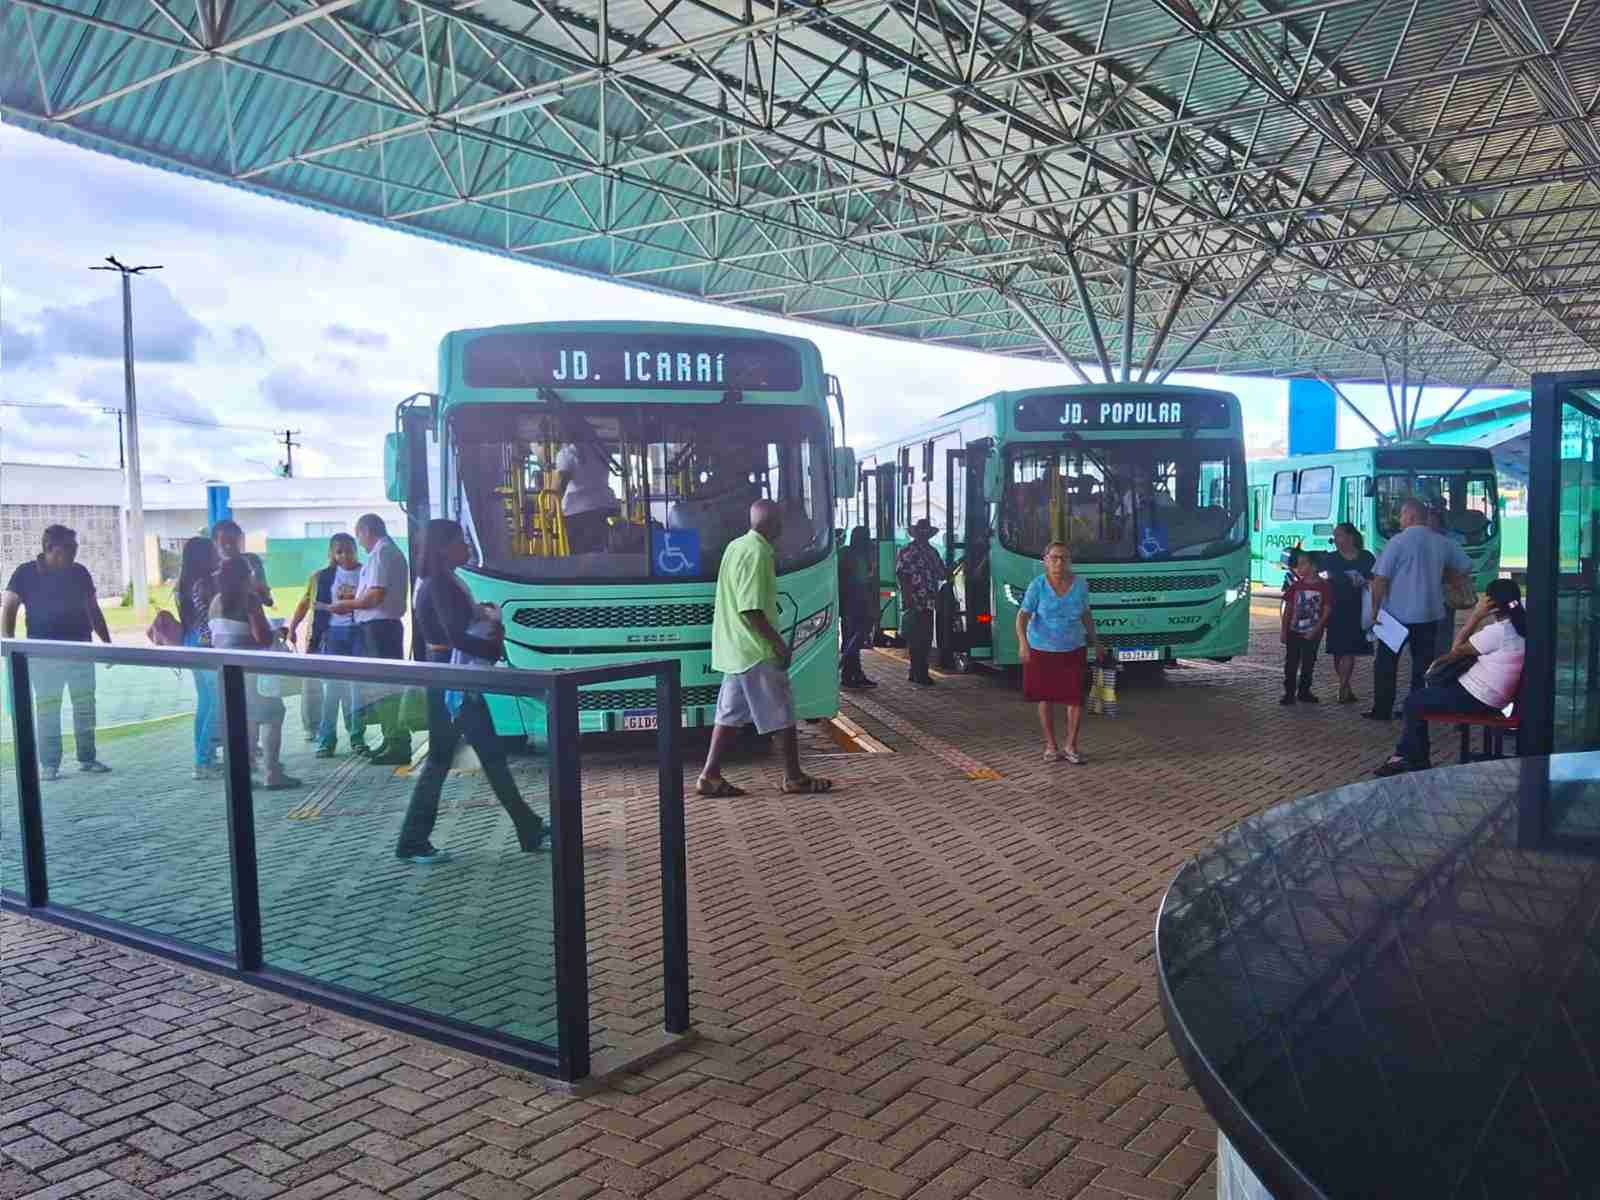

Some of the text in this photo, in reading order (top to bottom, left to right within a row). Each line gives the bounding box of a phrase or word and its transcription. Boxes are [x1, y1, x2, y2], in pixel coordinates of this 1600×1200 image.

[553, 350, 600, 380] JD.
[1060, 402, 1181, 424] JD. POPULAR
